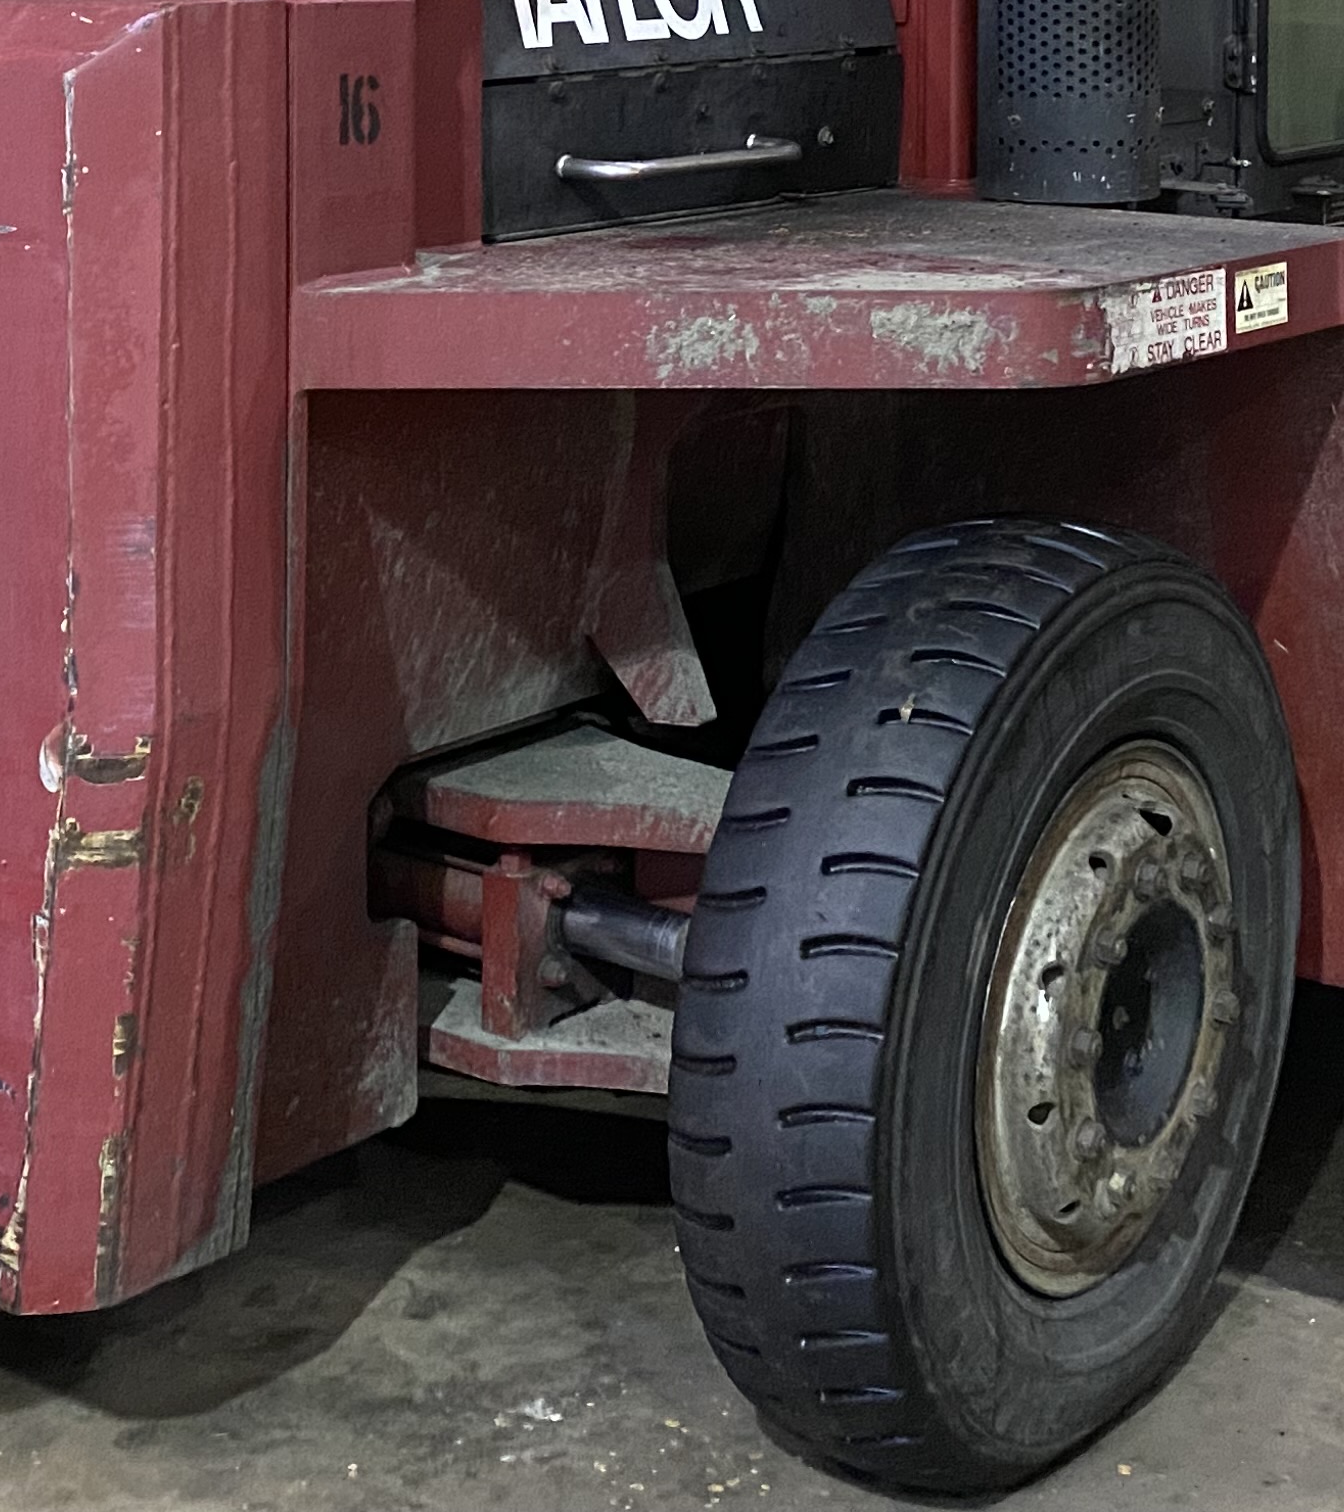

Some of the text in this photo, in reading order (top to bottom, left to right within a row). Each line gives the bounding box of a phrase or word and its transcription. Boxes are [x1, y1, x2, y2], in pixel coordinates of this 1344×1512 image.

[339, 73, 381, 145] 16
[1166, 273, 1214, 300] DANGER
[1150, 298, 1217, 322] VEHICLE MAKES
[1157, 314, 1209, 336] WIDE TURNS
[1147, 329, 1221, 363] STAY CLEAR
